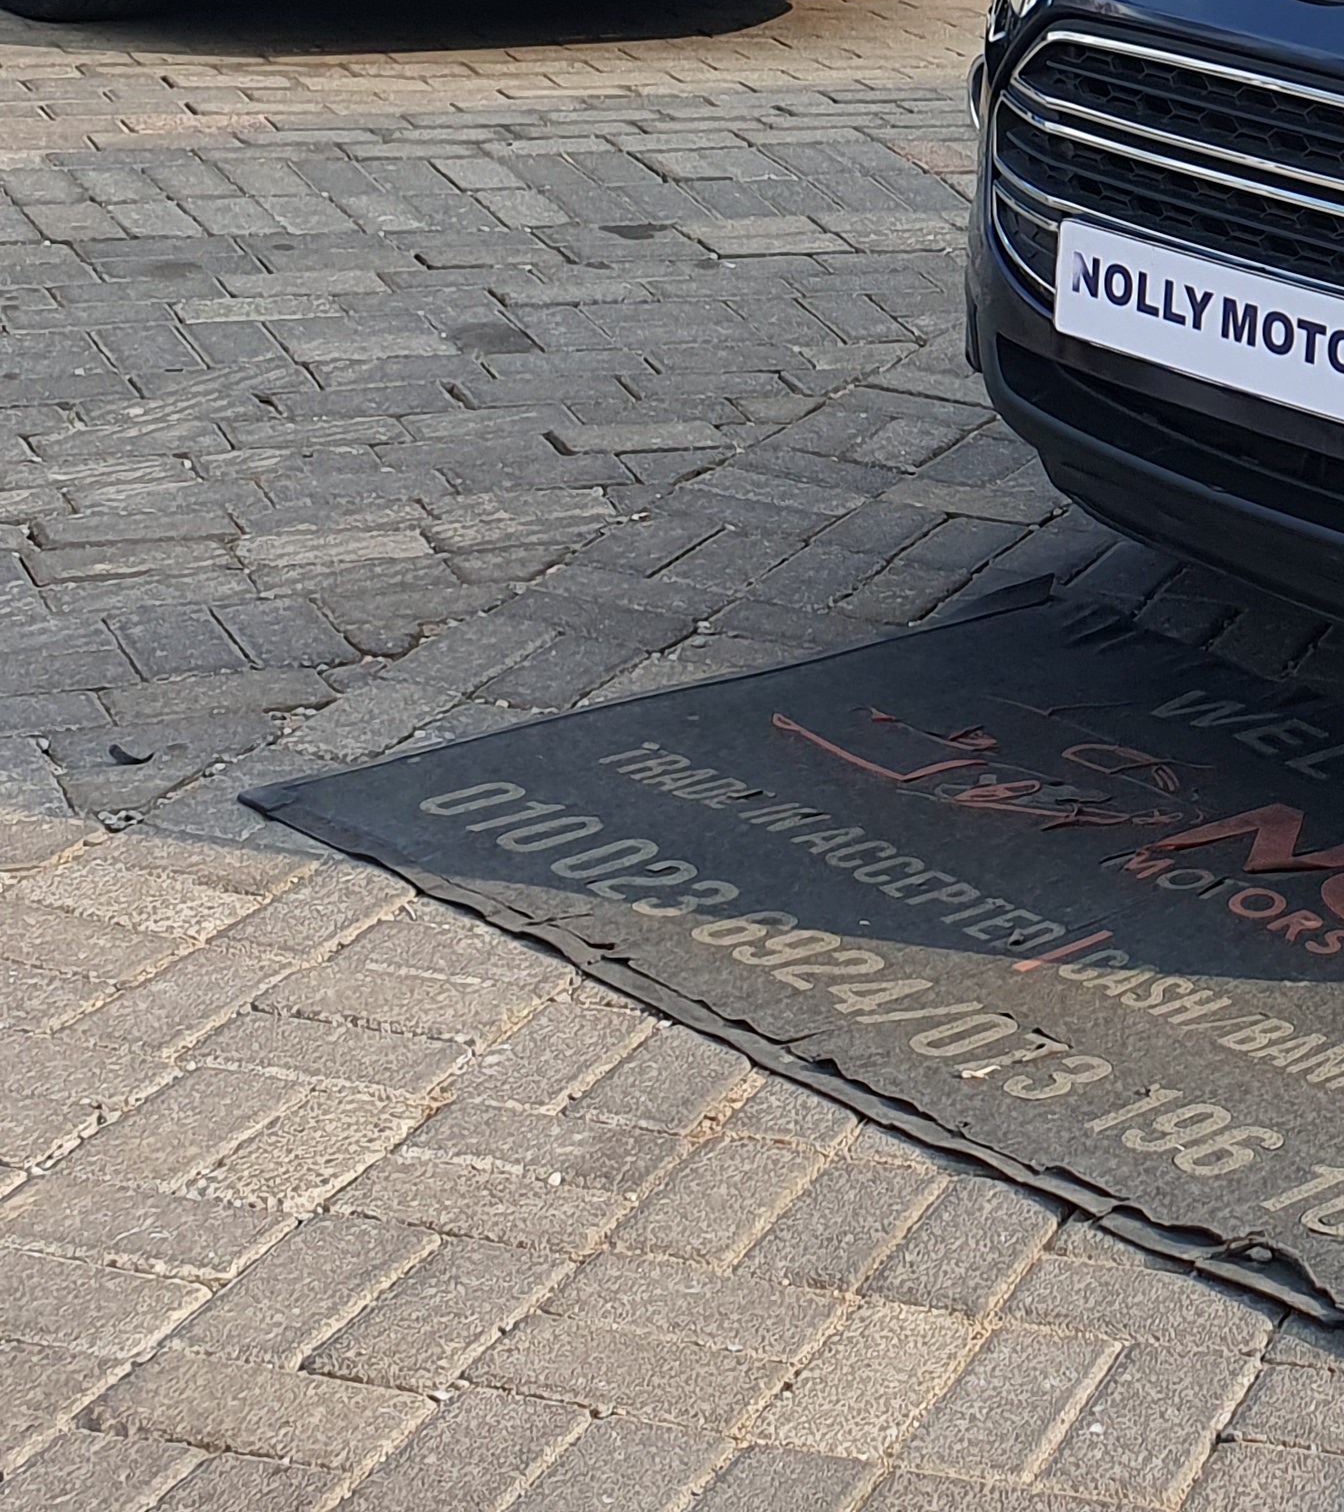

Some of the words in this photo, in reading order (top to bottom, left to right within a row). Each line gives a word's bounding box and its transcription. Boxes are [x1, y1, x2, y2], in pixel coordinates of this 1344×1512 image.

[1071, 250, 1214, 331] NOLLY
[597, 741, 776, 810] TRADE
[737, 802, 831, 832] IN
[790, 826, 1067, 952] ACCEPTED
[419, 781, 604, 854] 010
[550, 838, 739, 917] 023
[1084, 1083, 1285, 1177] 196
